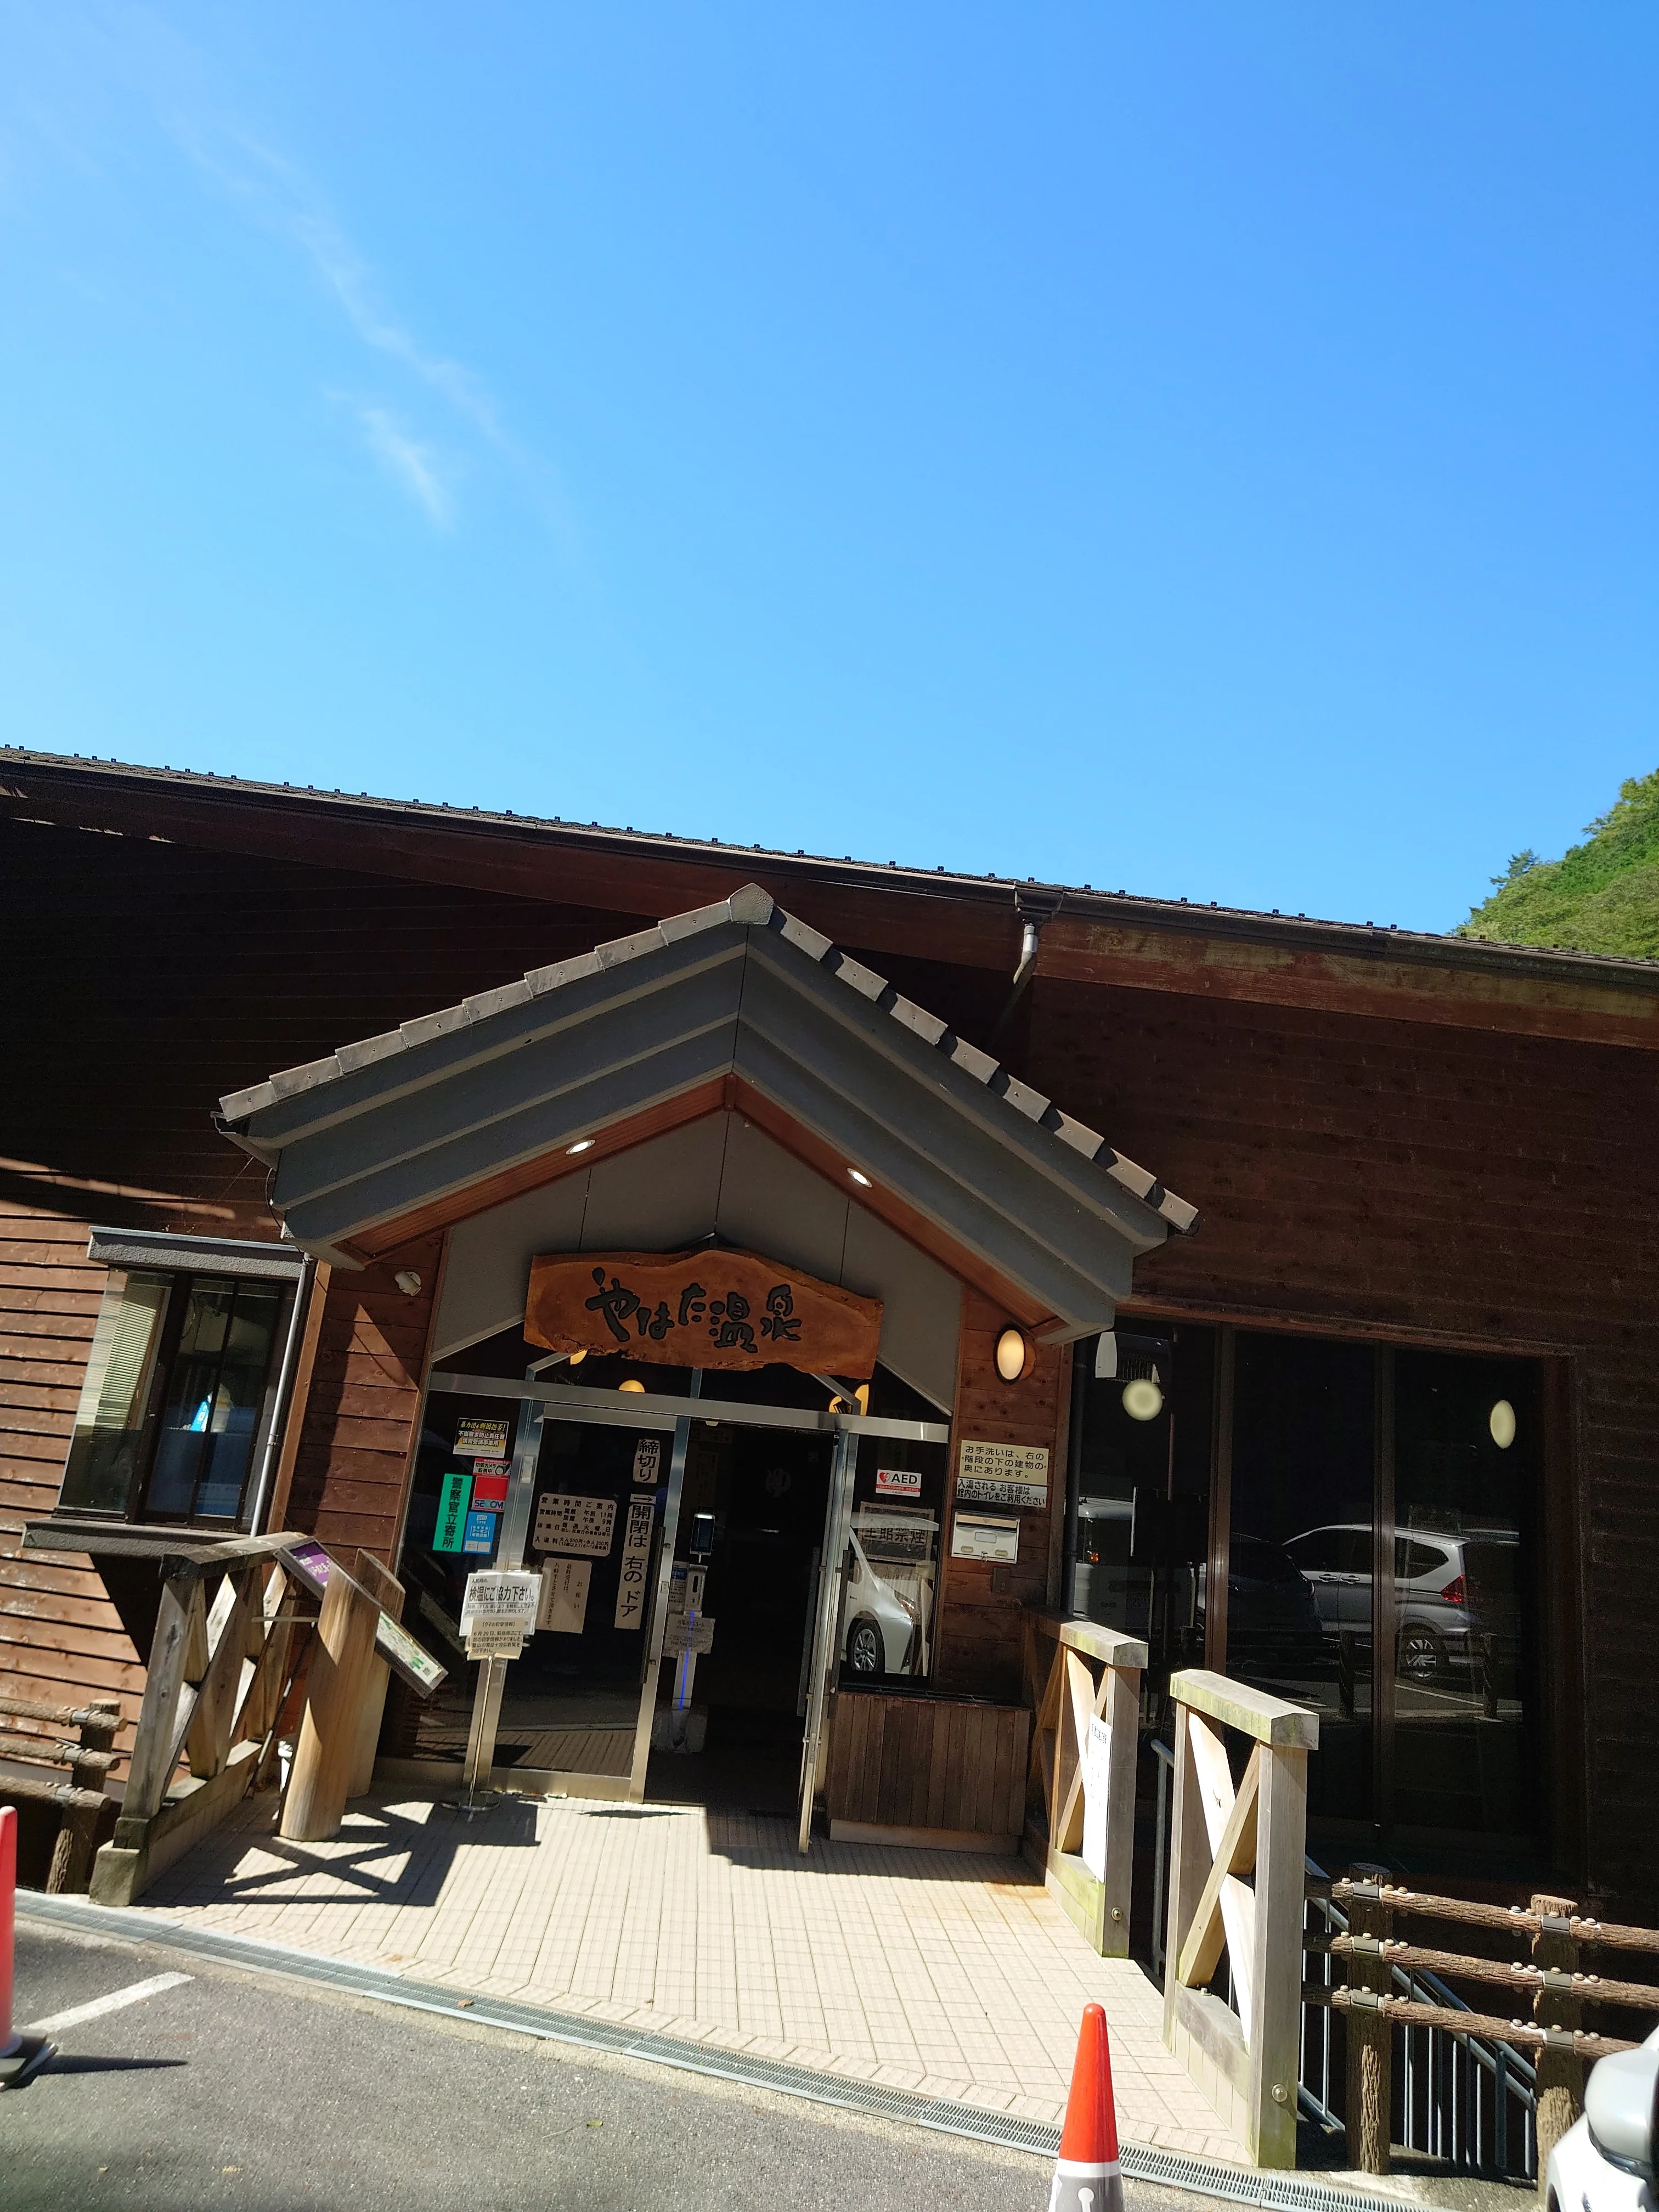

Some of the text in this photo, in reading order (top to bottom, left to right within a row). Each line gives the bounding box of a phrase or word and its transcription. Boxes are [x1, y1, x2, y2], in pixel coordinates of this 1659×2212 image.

[585, 1267, 803, 1354] やはた温泉
[637, 1440, 658, 1481] 締切り
[966, 1445, 1044, 1460] お手洗いは、右の
[964, 1455, 1043, 1470] 階段の下の建物の
[891, 1473, 918, 1484] AED
[964, 1464, 1029, 1479] 奥にあります。
[958, 1479, 1030, 1495] 入湯される お客様は
[475, 1500, 504, 1509] SECOM
[541, 1497, 614, 1510] 営業時間ご案内
[957, 1488, 1045, 1505] 館内のトイレをご利用ください
[442, 1477, 463, 1549] 警察官立寄所
[562, 1522, 610, 1532] 毎週火曜日
[620, 1505, 651, 1617] 開閉は 右の ドア
[469, 1585, 534, 1601] 検温にご協力下さい。
[574, 1581, 583, 1609] お願い
